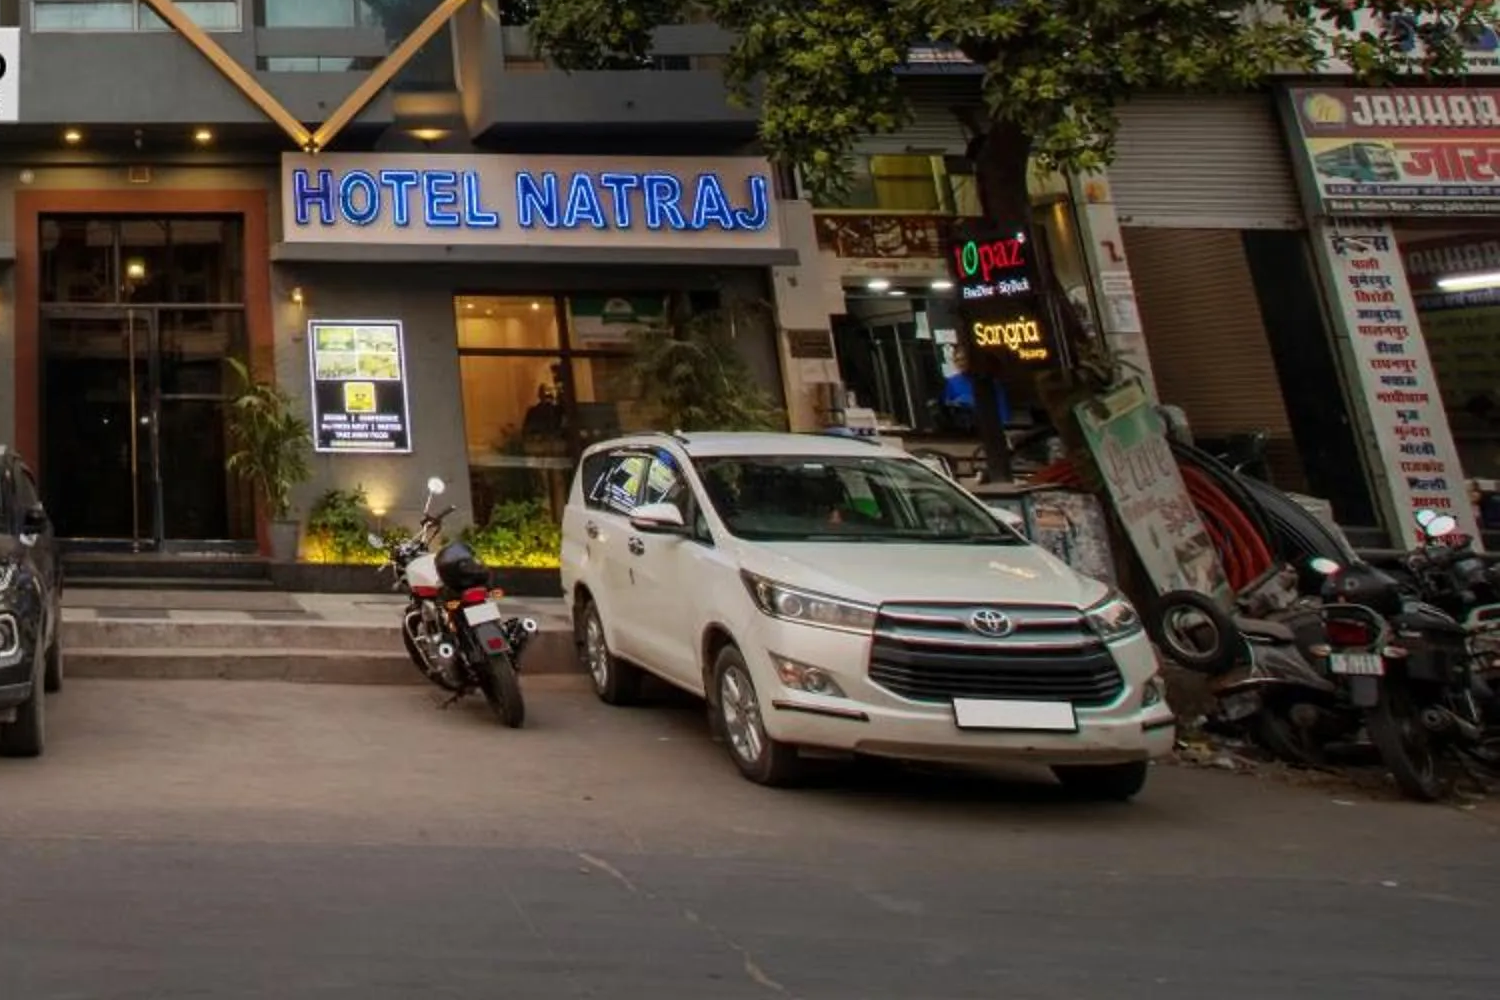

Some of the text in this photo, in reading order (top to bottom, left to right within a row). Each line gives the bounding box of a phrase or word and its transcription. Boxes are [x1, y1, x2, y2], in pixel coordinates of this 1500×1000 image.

[293, 169, 769, 231] HOTEL NATRAJ
[953, 237, 1025, 282] topaz
[974, 316, 1040, 349] Sangria
